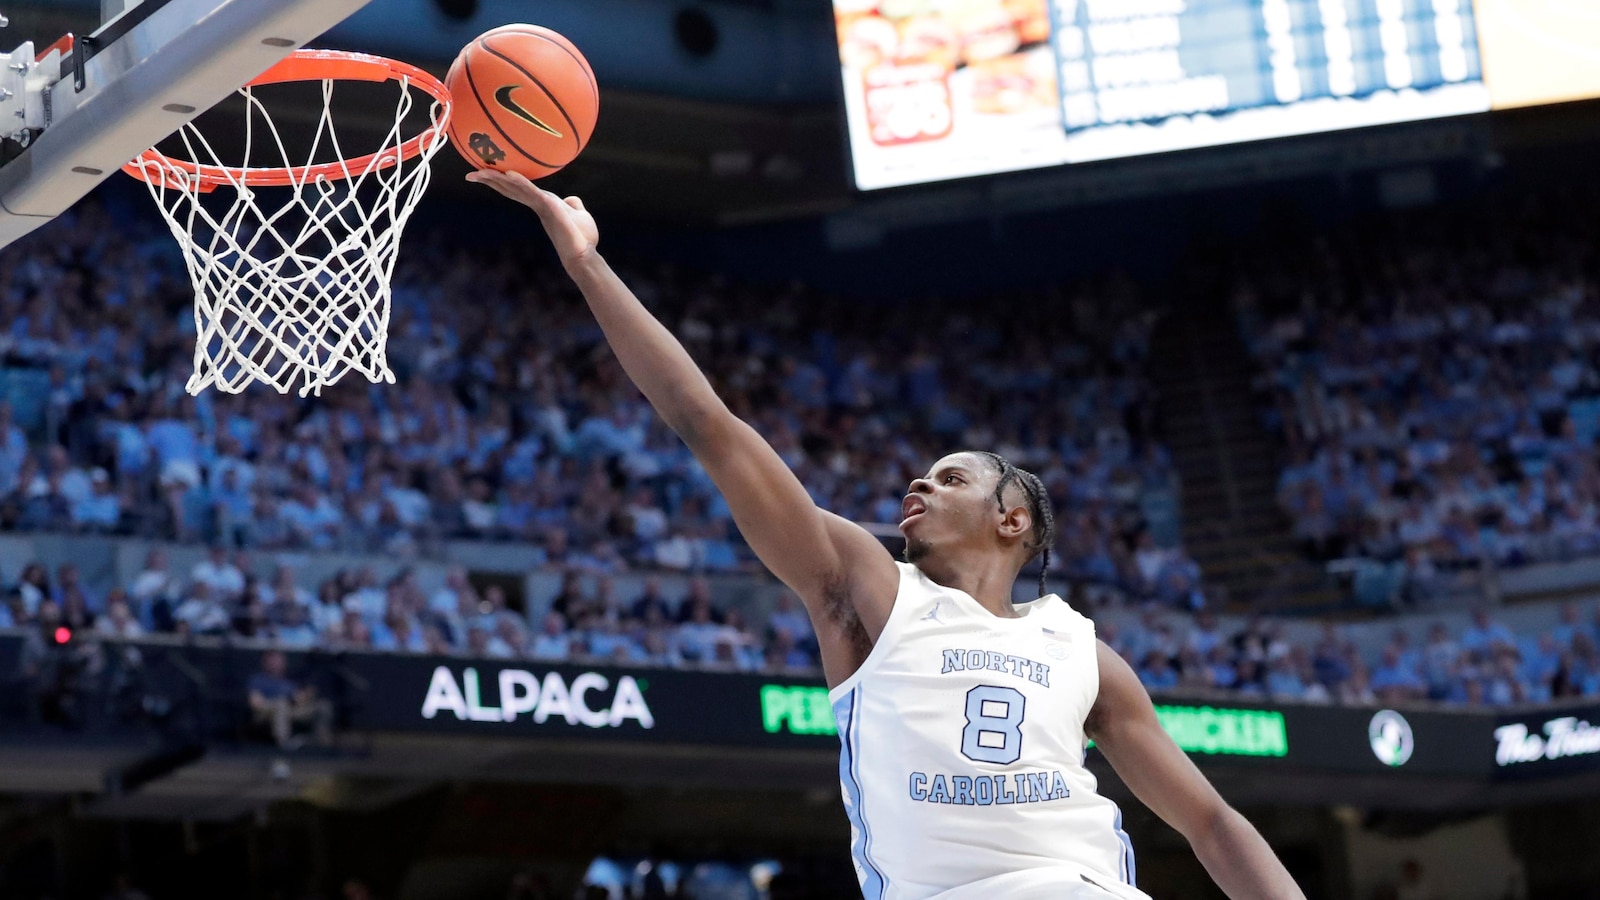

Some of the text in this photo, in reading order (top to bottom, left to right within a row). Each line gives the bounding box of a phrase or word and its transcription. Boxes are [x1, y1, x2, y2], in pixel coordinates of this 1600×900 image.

[941, 649, 1050, 688] NORTH
[421, 666, 655, 729] ALPACA
[961, 684, 1026, 766] 8
[909, 770, 1070, 806] CAROLINA
